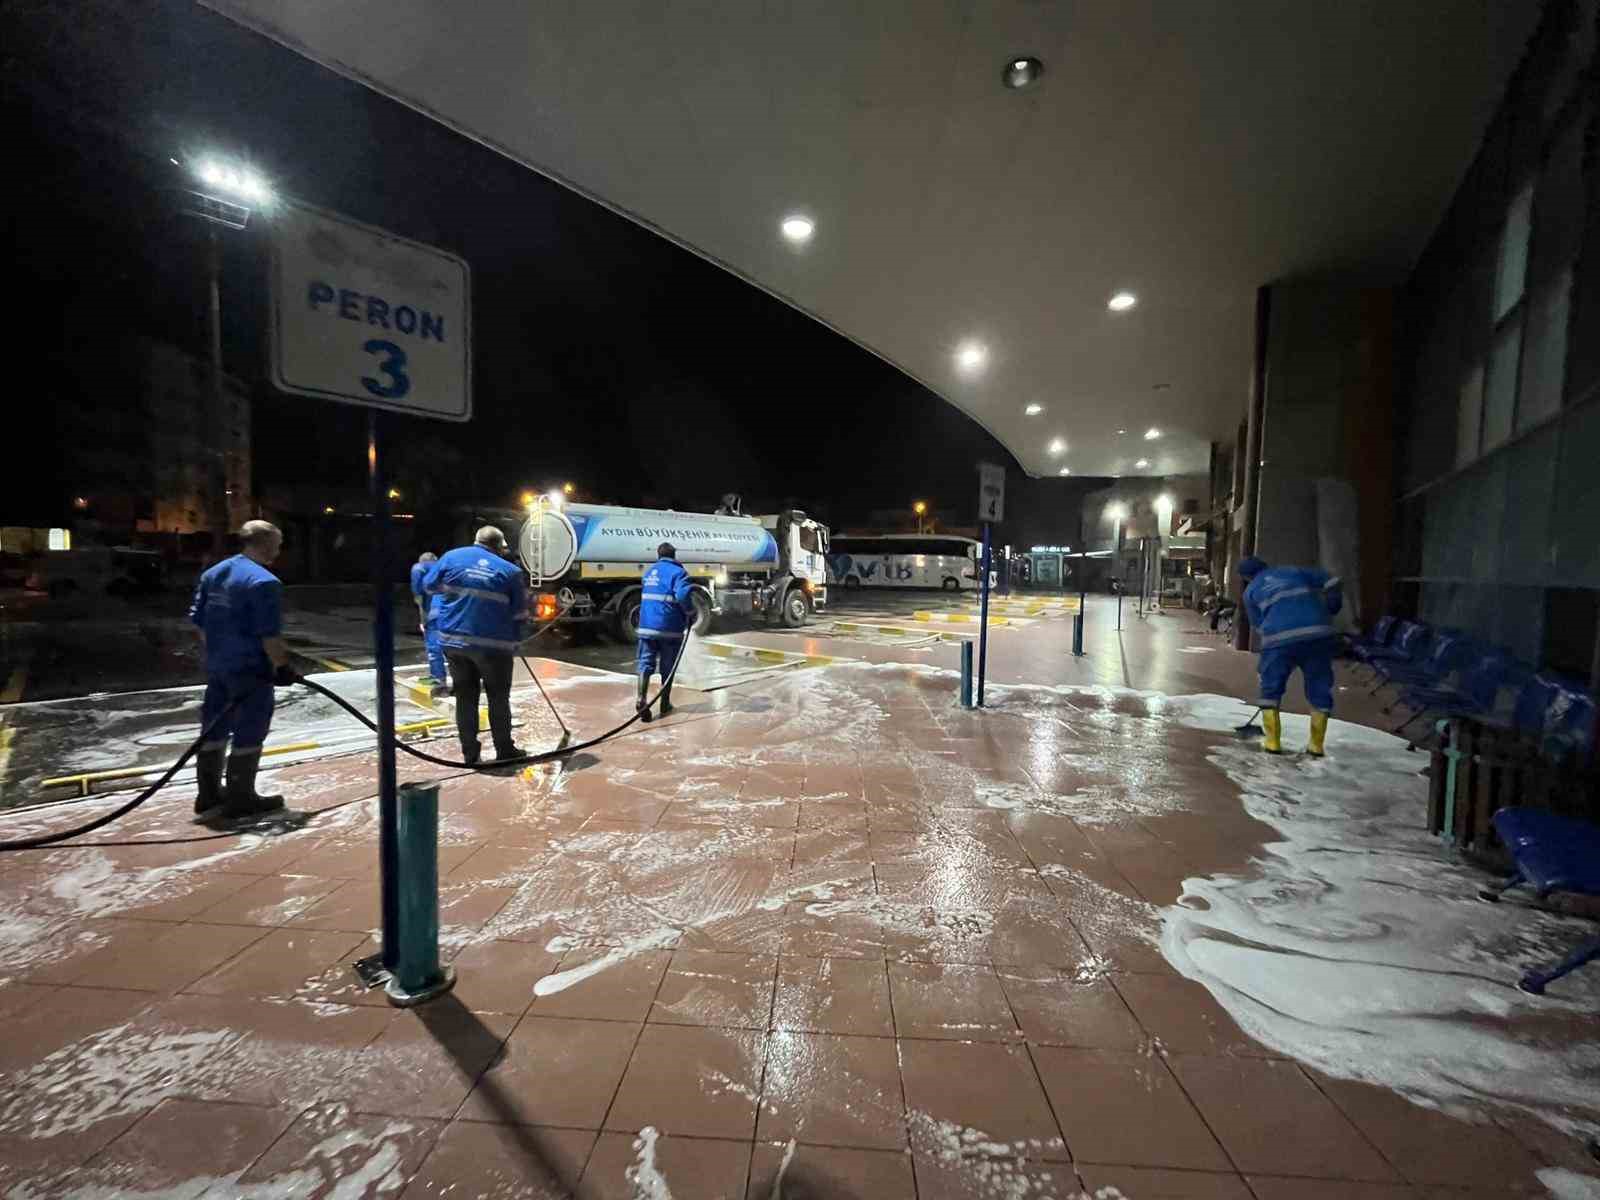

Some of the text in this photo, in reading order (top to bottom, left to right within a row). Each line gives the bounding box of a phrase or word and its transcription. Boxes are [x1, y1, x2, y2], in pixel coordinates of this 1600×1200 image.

[308, 281, 444, 343] PERON
[361, 339, 410, 398] 3
[601, 528, 635, 537] AYDIN
